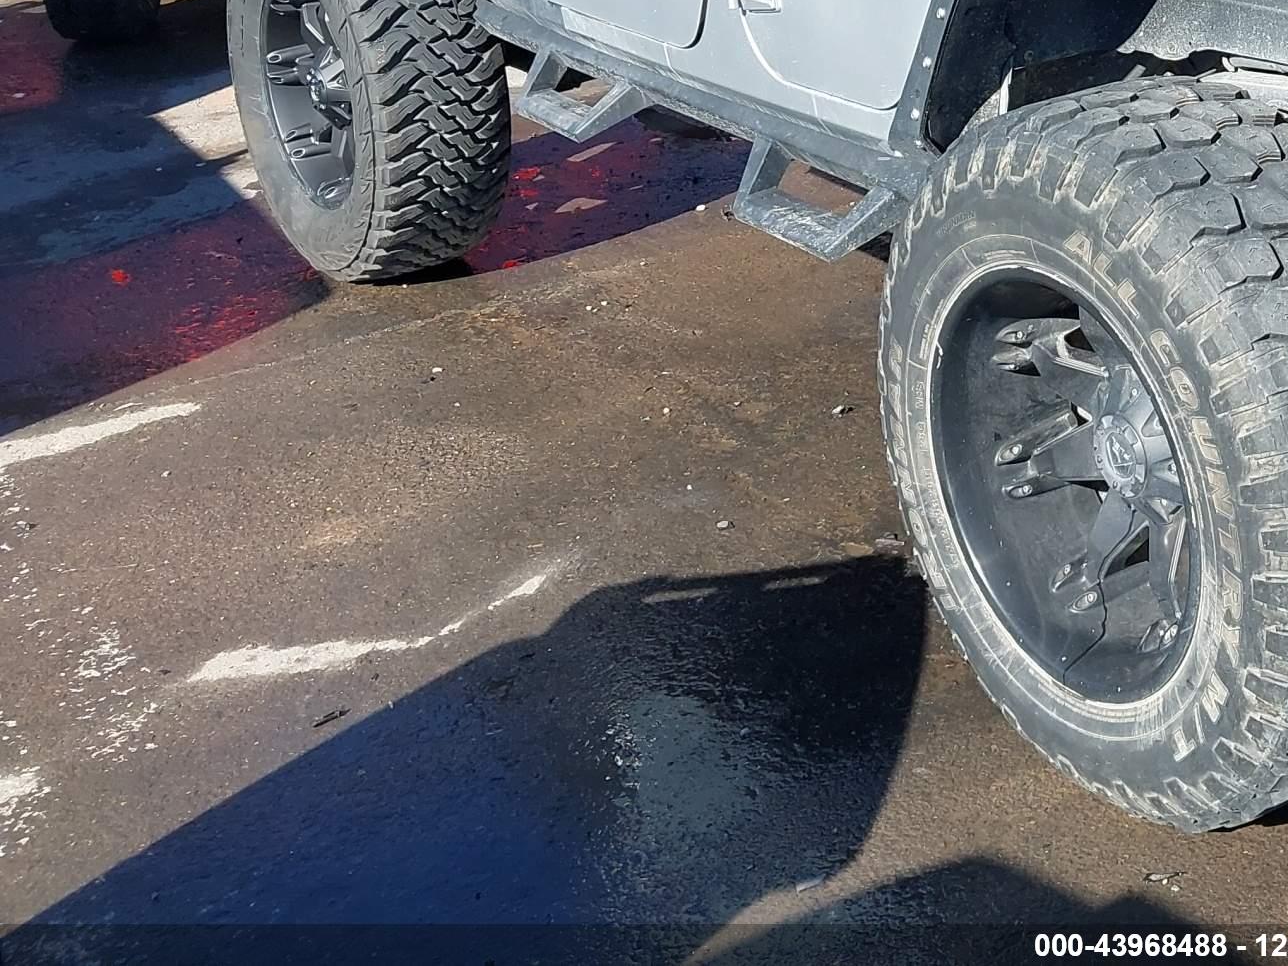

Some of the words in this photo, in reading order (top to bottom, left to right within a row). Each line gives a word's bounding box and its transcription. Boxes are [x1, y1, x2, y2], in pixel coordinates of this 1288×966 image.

[1062, 230, 1141, 317] ALL
[888, 337, 963, 614] IRONMAN
[1149, 328, 1243, 668] COUNTRY
[1171, 668, 1231, 762] M/T
